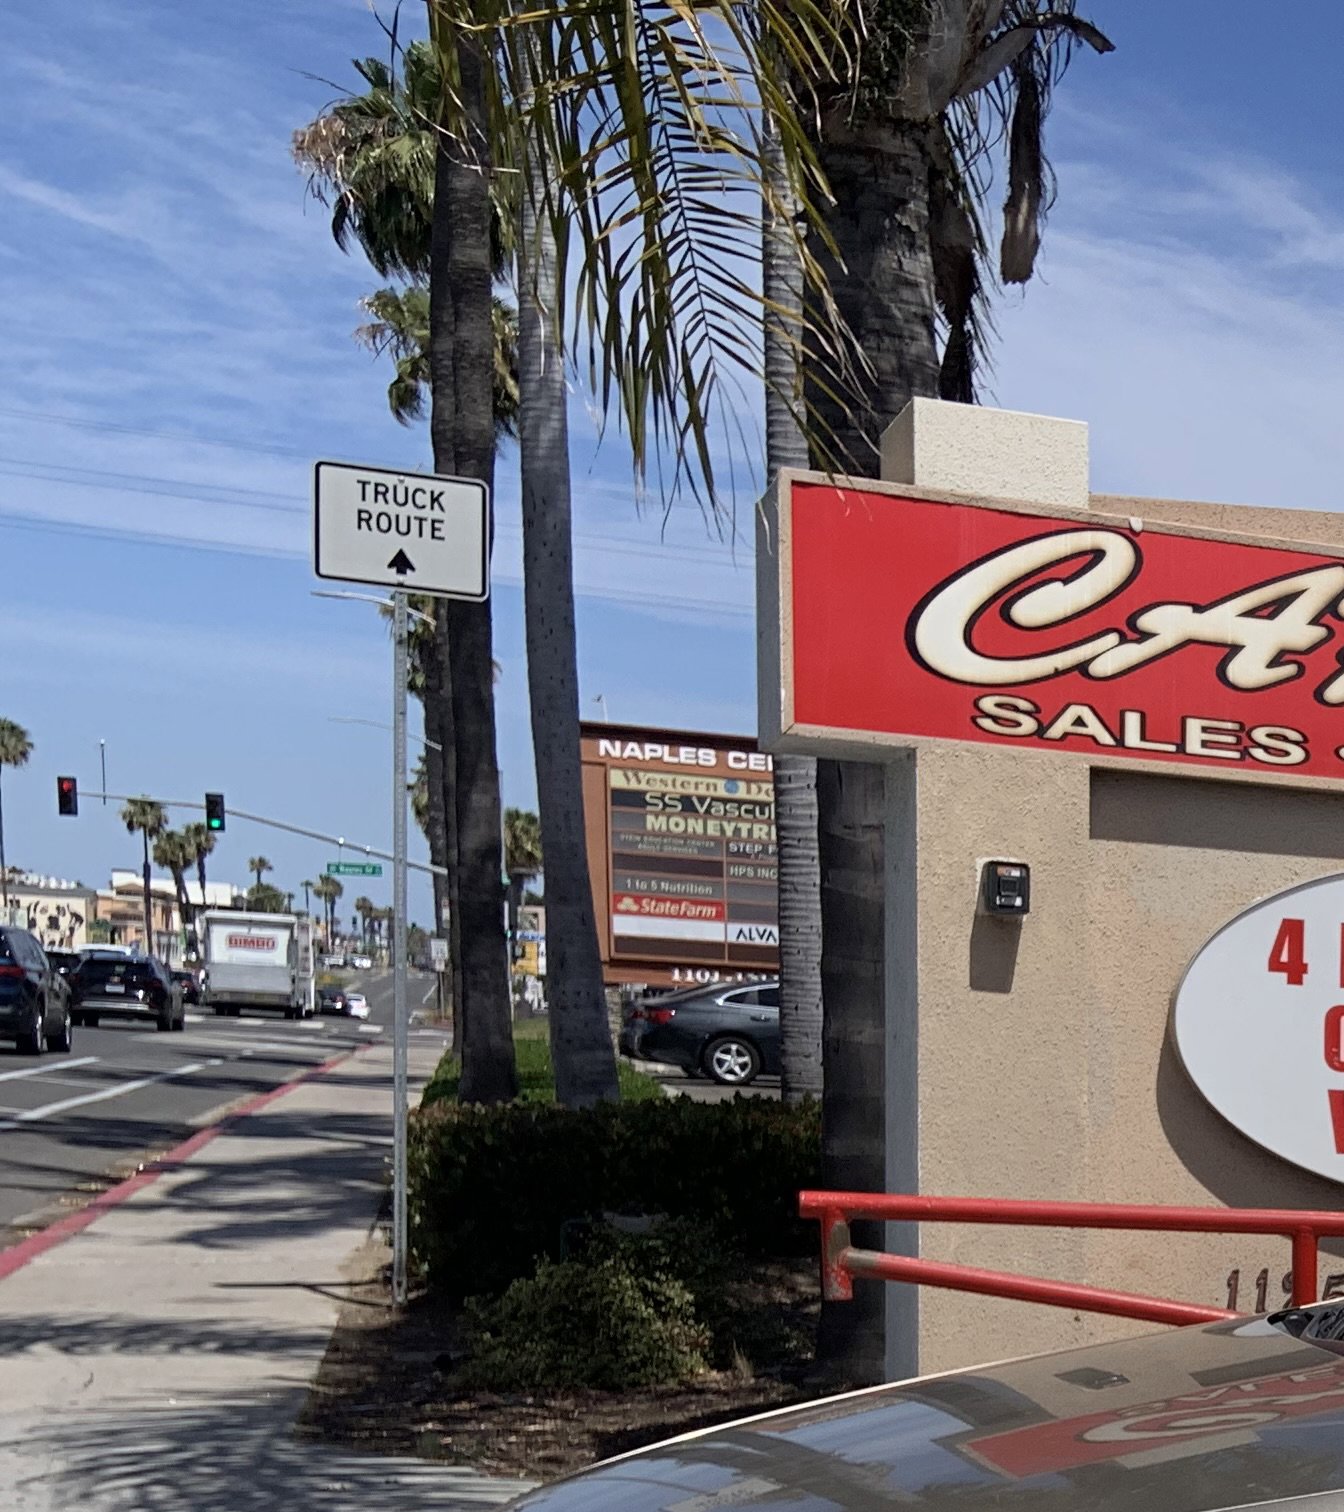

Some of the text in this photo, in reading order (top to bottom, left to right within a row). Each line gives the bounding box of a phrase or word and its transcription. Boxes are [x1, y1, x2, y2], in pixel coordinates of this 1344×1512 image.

[356, 479, 446, 513] TRUCK
[356, 508, 446, 541] ROUTE
[971, 693, 1310, 766] SALES
[599, 739, 717, 767] NAPLES
[622, 770, 718, 793] Western
[645, 792, 683, 812] SS
[729, 841, 763, 855] STEP
[626, 879, 713, 895] 1 to 5 Nutrition
[640, 898, 717, 918] StateFarm
[1268, 918, 1309, 986] 4
